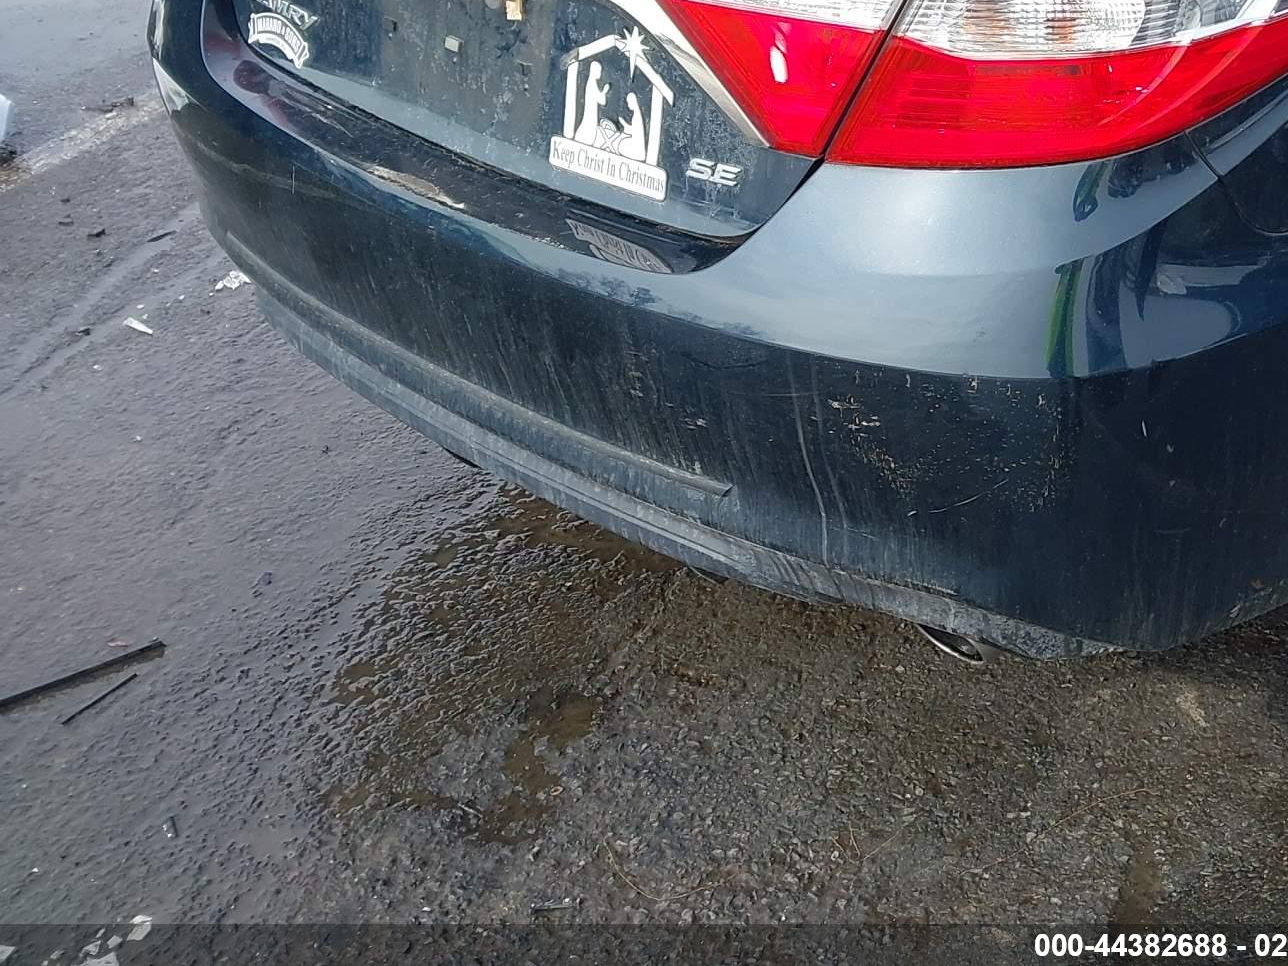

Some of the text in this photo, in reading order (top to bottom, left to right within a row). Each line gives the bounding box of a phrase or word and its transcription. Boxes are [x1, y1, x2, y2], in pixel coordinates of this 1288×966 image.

[552, 139, 665, 193] Keep Christ In Christmas
[685, 157, 743, 187] SE
